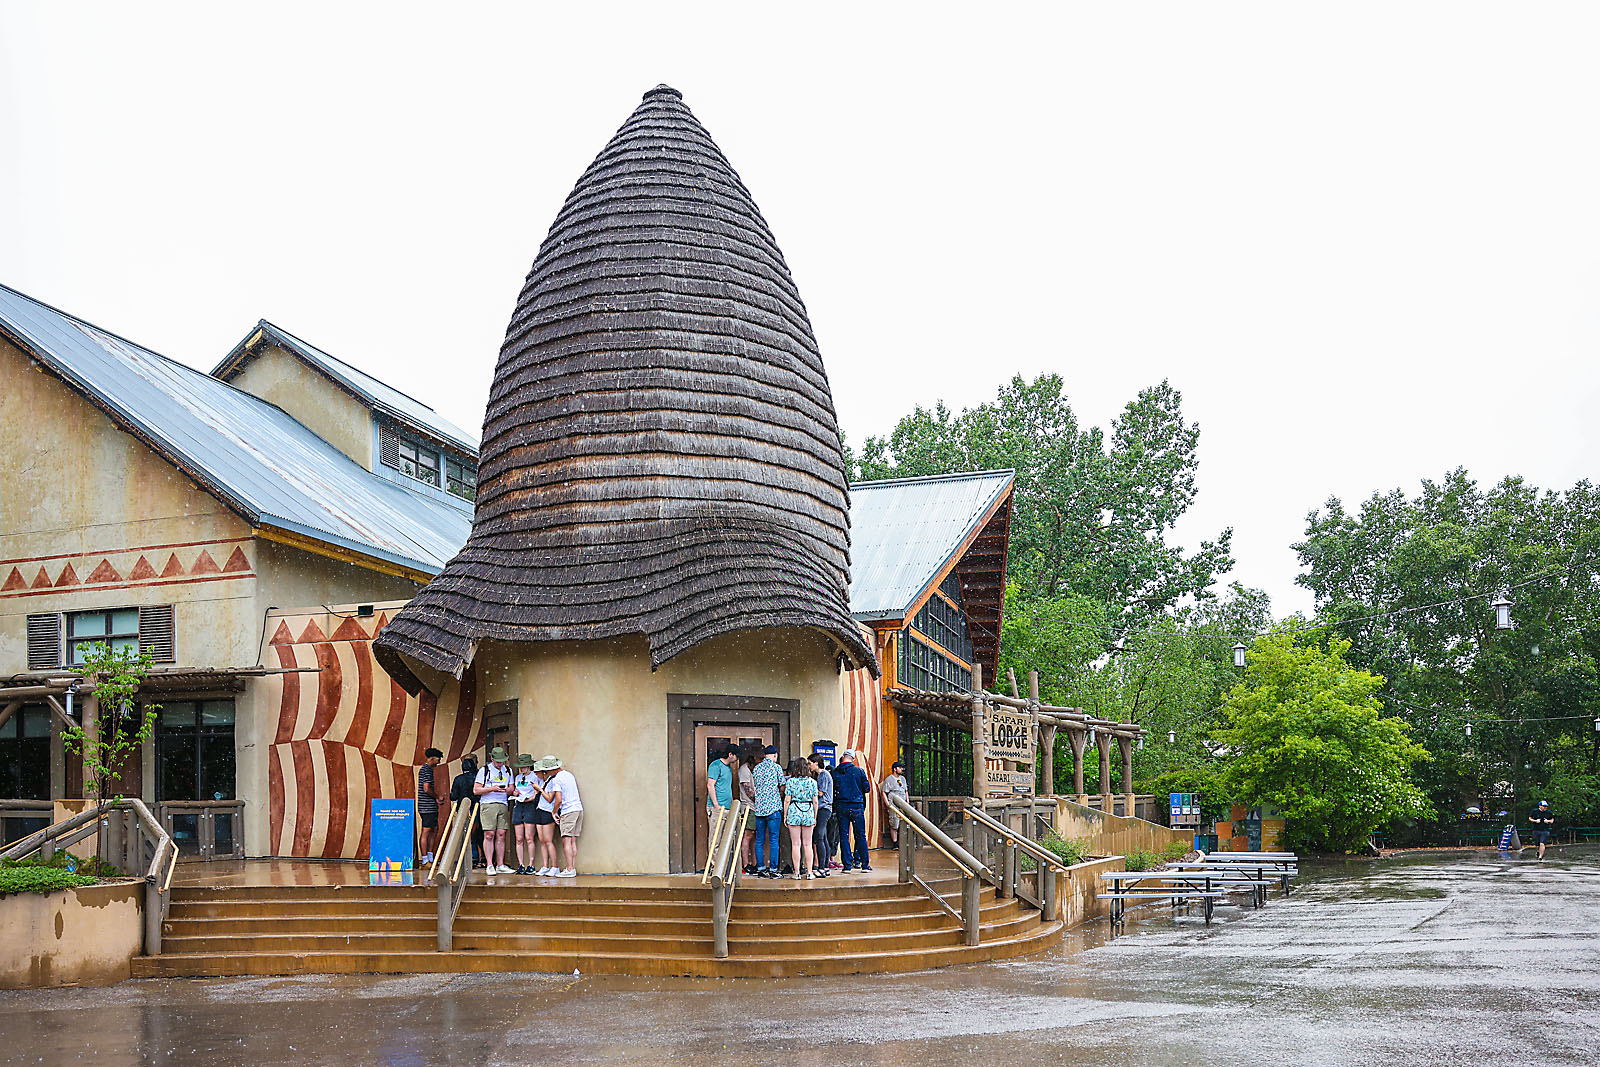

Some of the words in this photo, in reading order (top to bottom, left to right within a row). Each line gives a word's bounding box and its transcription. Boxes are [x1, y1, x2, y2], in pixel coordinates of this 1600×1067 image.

[992, 714, 1027, 726] SAFARI
[991, 722, 1028, 749] LODGE
[987, 772, 1010, 783] SAFARI
